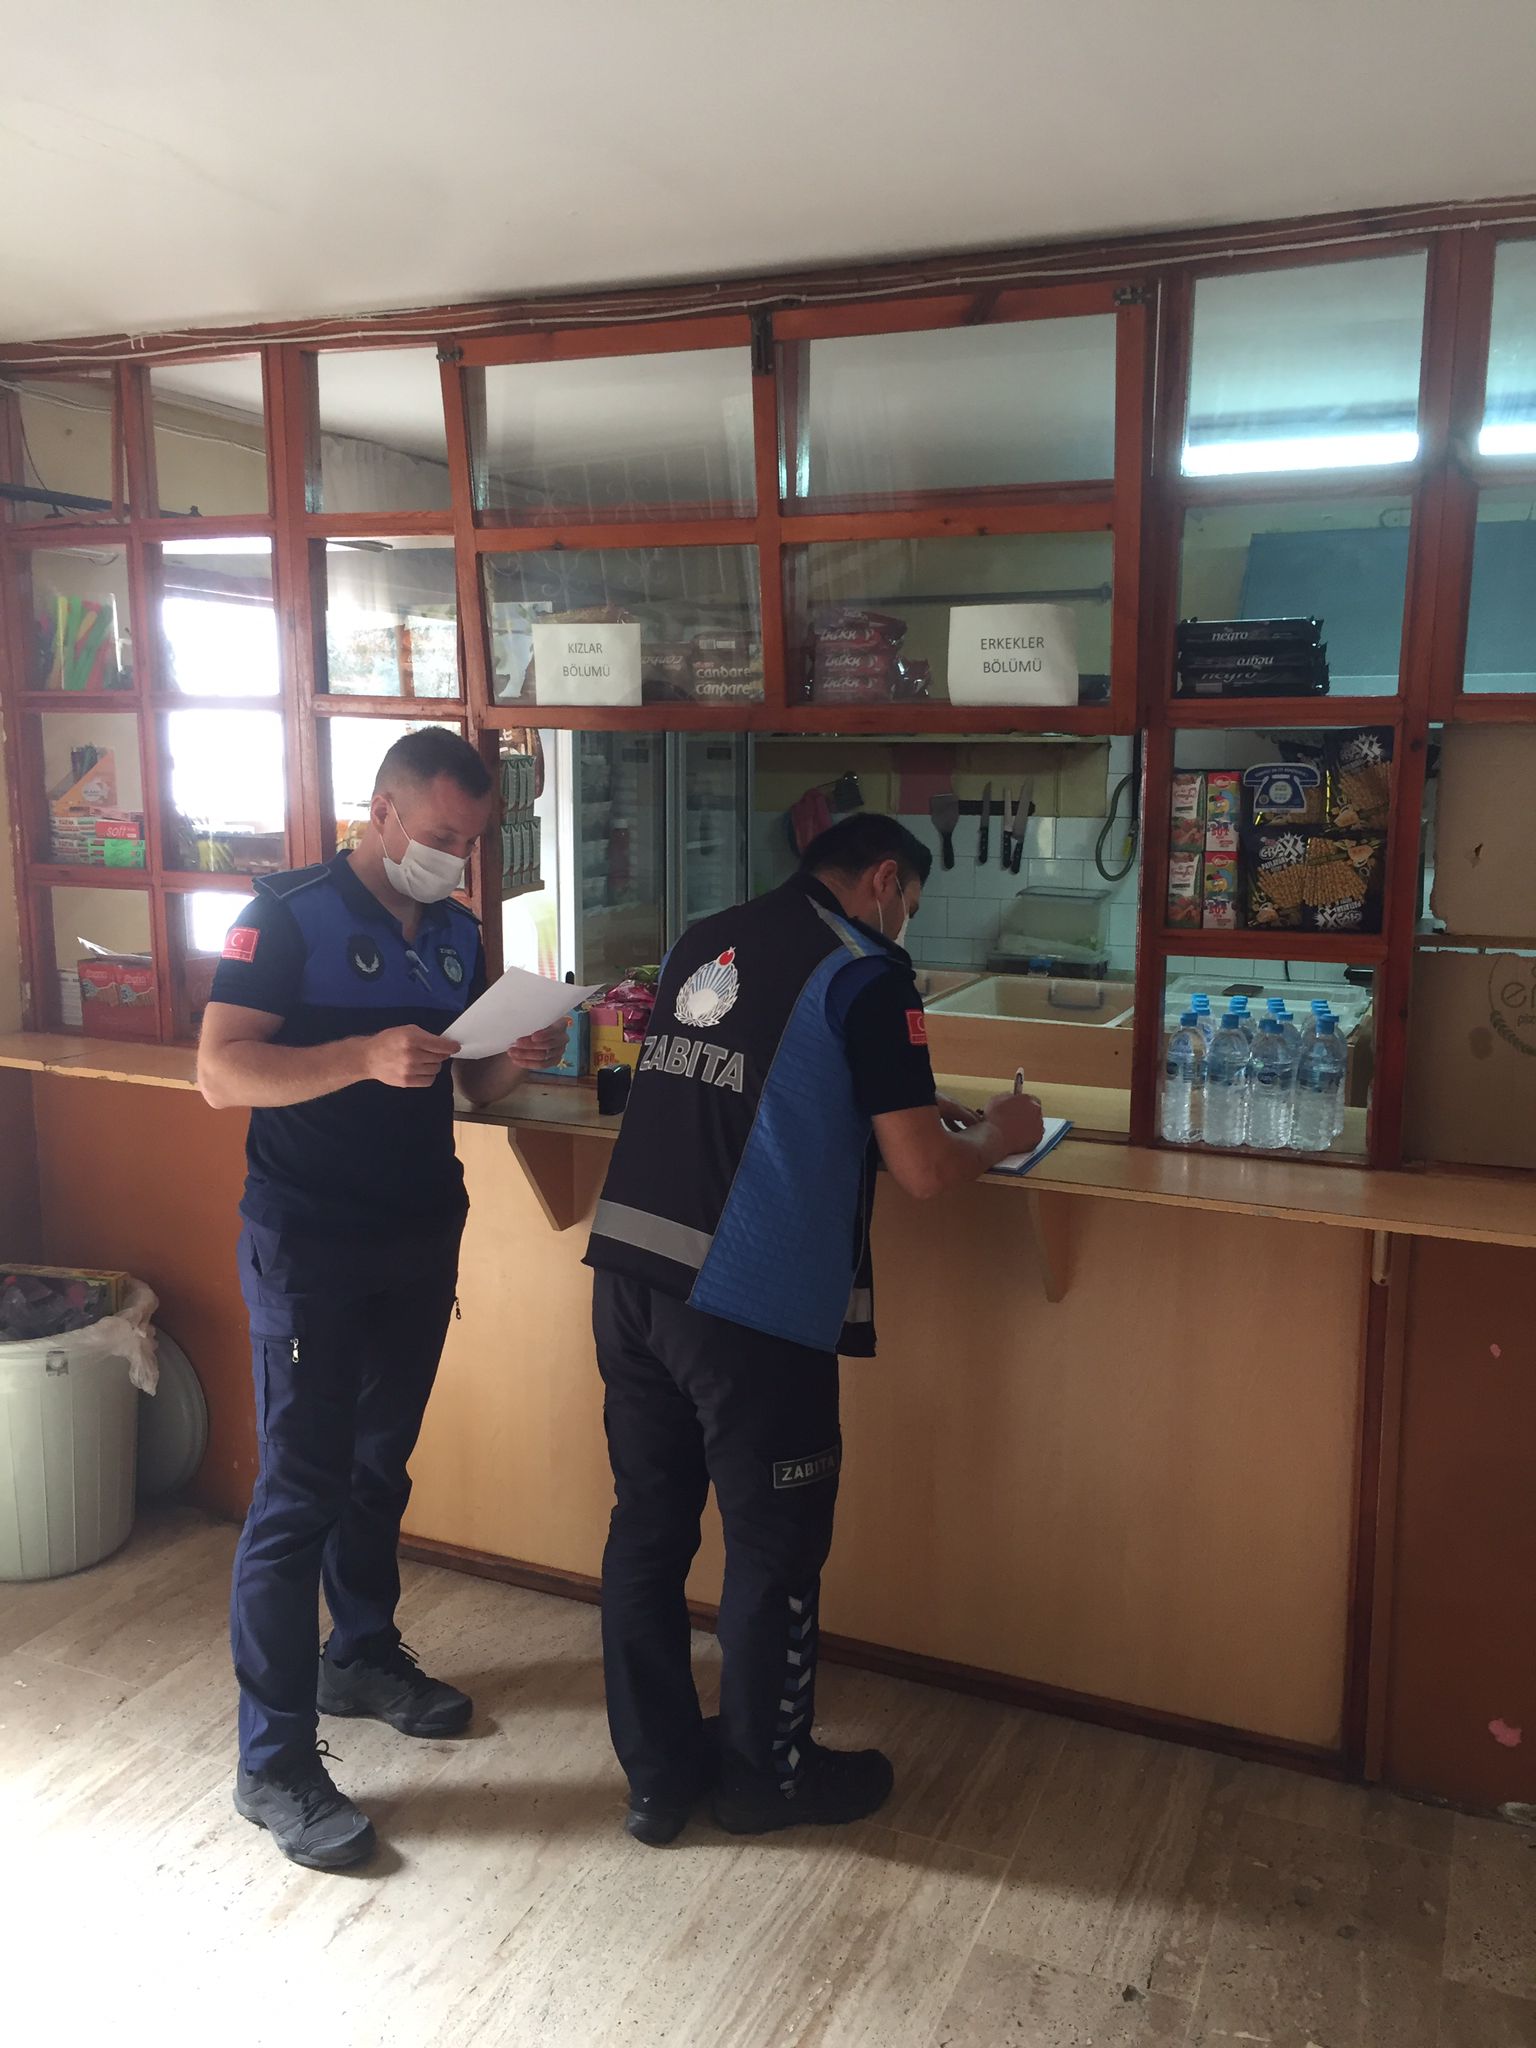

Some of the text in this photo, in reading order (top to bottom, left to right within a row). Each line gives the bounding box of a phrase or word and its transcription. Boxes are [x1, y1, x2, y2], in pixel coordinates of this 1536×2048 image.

[981, 637, 1044, 650] ERKEKLER
[1212, 631, 1248, 642] negro
[568, 642, 603, 654] KIZLAR
[983, 658, 1042, 673] BÖLÜMÜ
[1259, 838, 1301, 860] CRAX
[639, 1034, 744, 1094] ZABITA
[782, 1455, 835, 1481] ZABITA
